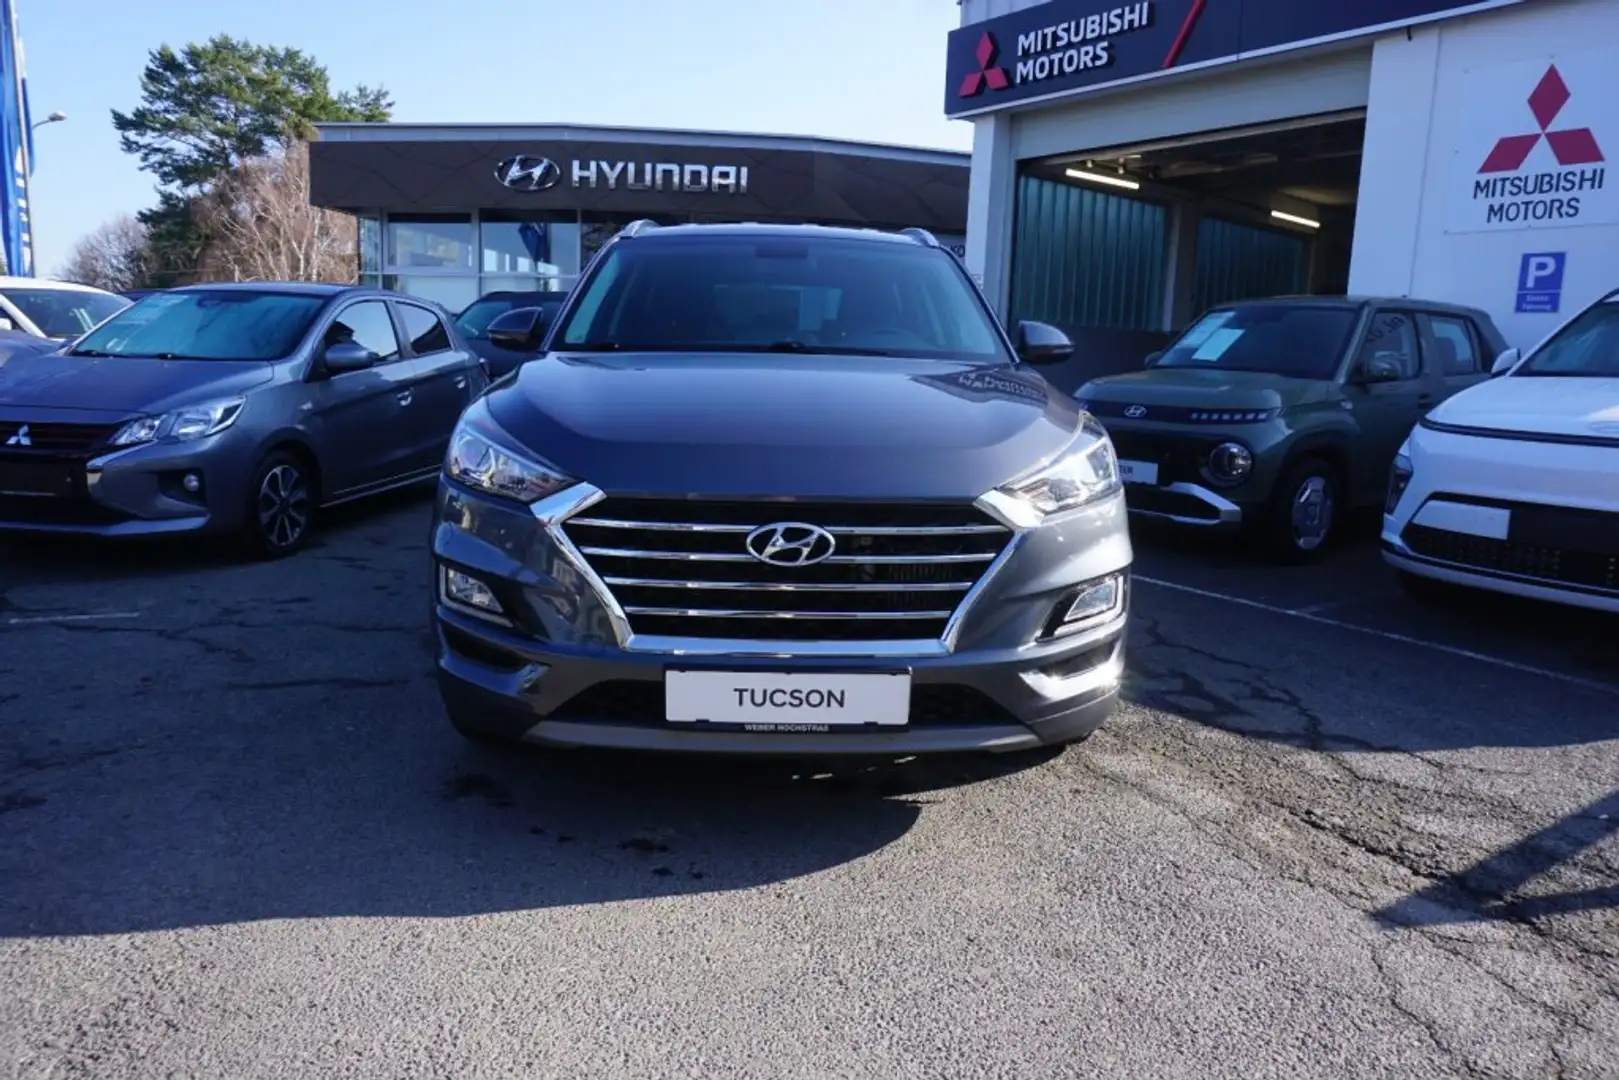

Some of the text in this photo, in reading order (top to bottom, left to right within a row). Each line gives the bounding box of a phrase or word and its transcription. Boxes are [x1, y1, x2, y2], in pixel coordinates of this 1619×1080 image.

[1017, 1, 1149, 56] MITSUBISHI
[1016, 41, 1109, 83] MOTORS
[571, 159, 748, 194] HYUNDAI
[1473, 168, 1605, 199] MITSUBISHI
[1486, 197, 1581, 223] MOTORS
[1526, 256, 1556, 288] P
[733, 688, 845, 708] TUCSON
